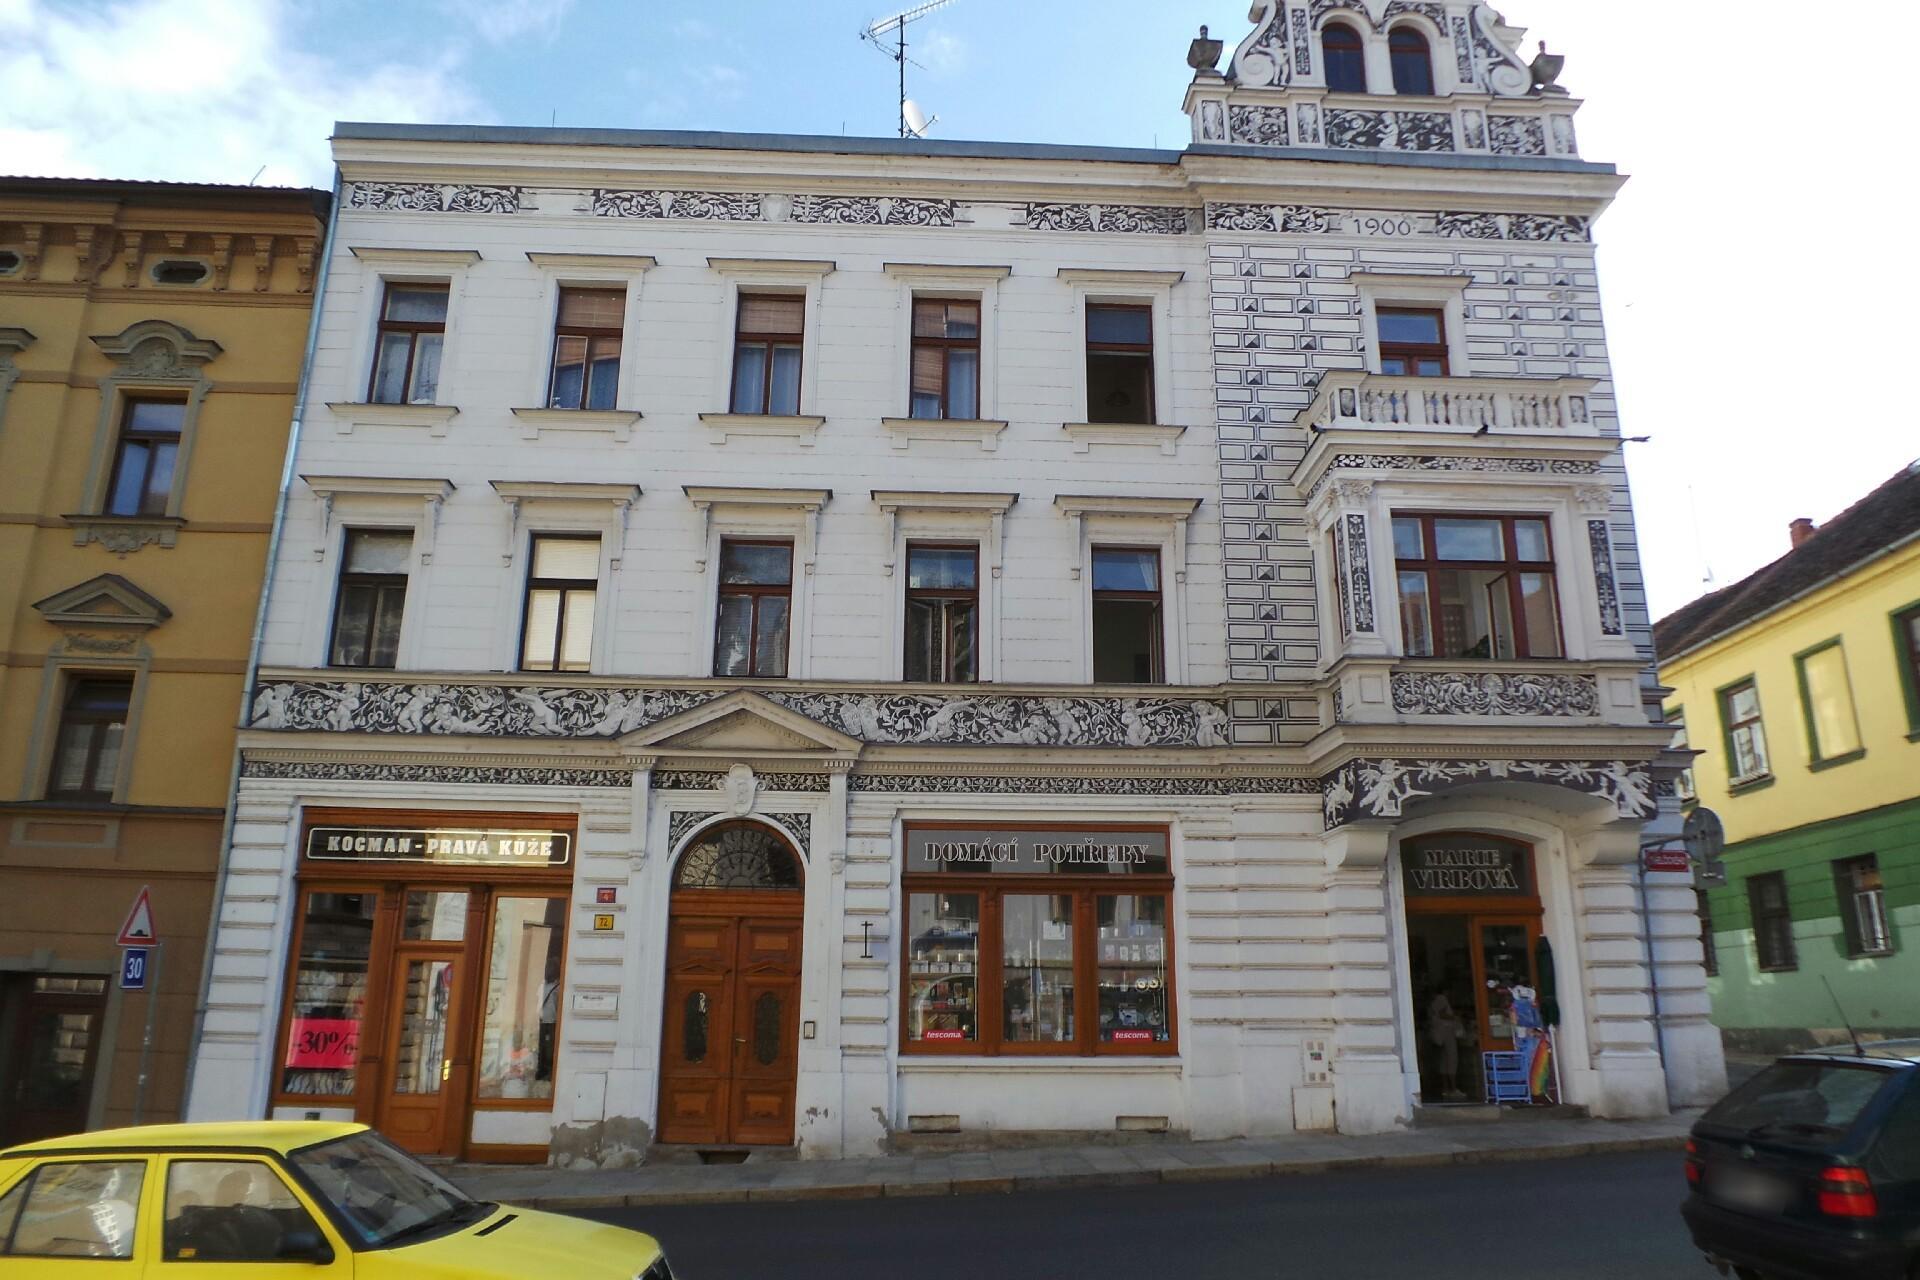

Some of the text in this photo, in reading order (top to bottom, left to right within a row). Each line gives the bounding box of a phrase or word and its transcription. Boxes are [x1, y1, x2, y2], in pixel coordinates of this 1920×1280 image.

[1353, 218, 1411, 236] 1900
[327, 835, 411, 854] KOCMAN
[426, 836, 489, 856] PRAVÁ
[924, 837, 1149, 864] DOMÁCÍ POTŘEBY
[1424, 849, 1500, 866] MARIE
[1410, 863, 1519, 890] VRBOVÁ
[126, 957, 144, 980] 30
[926, 1030, 962, 1040] tescoma
[1115, 1030, 1150, 1040] tescoma
